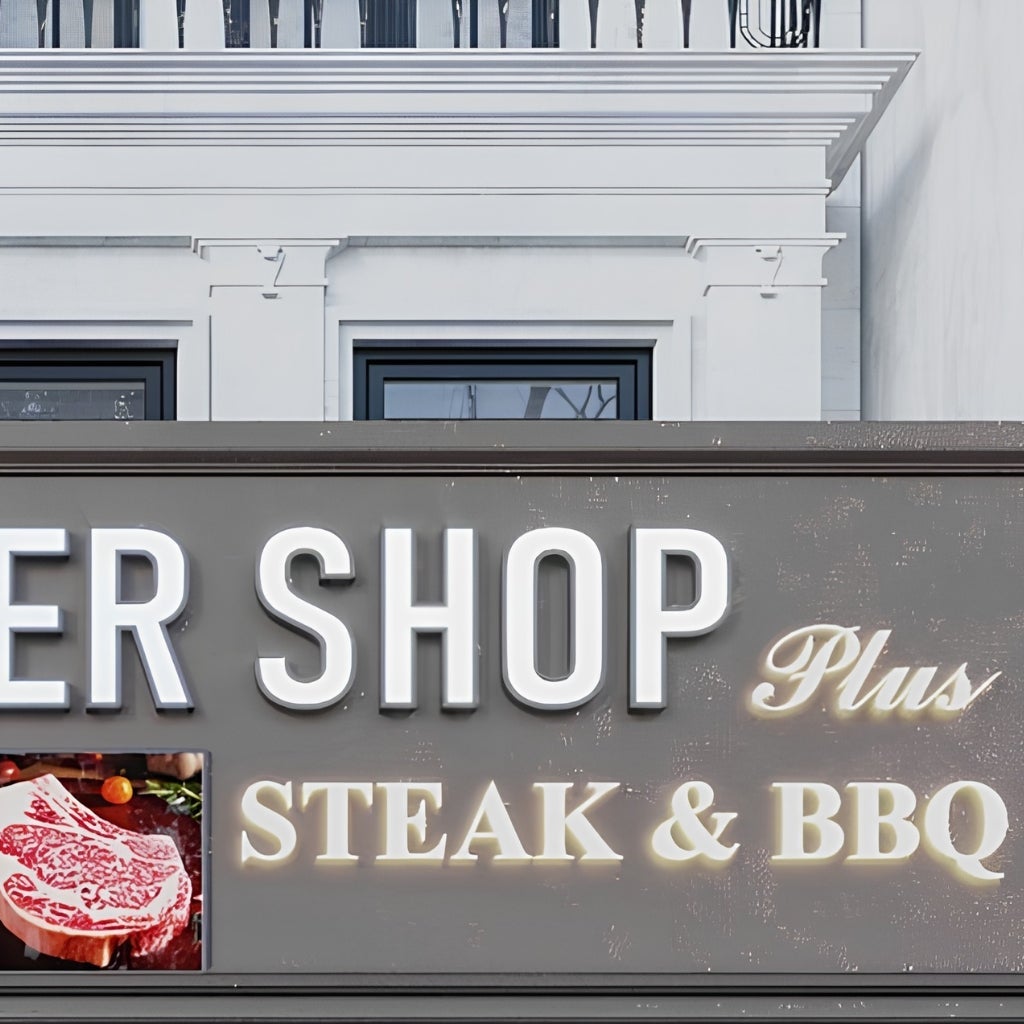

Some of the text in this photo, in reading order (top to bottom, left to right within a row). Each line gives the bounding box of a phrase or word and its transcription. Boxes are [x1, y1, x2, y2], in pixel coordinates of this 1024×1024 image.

[256, 526, 731, 709] SHOP
[750, 624, 1002, 712] Plus
[241, 780, 1010, 880] STEAK & BBQ
